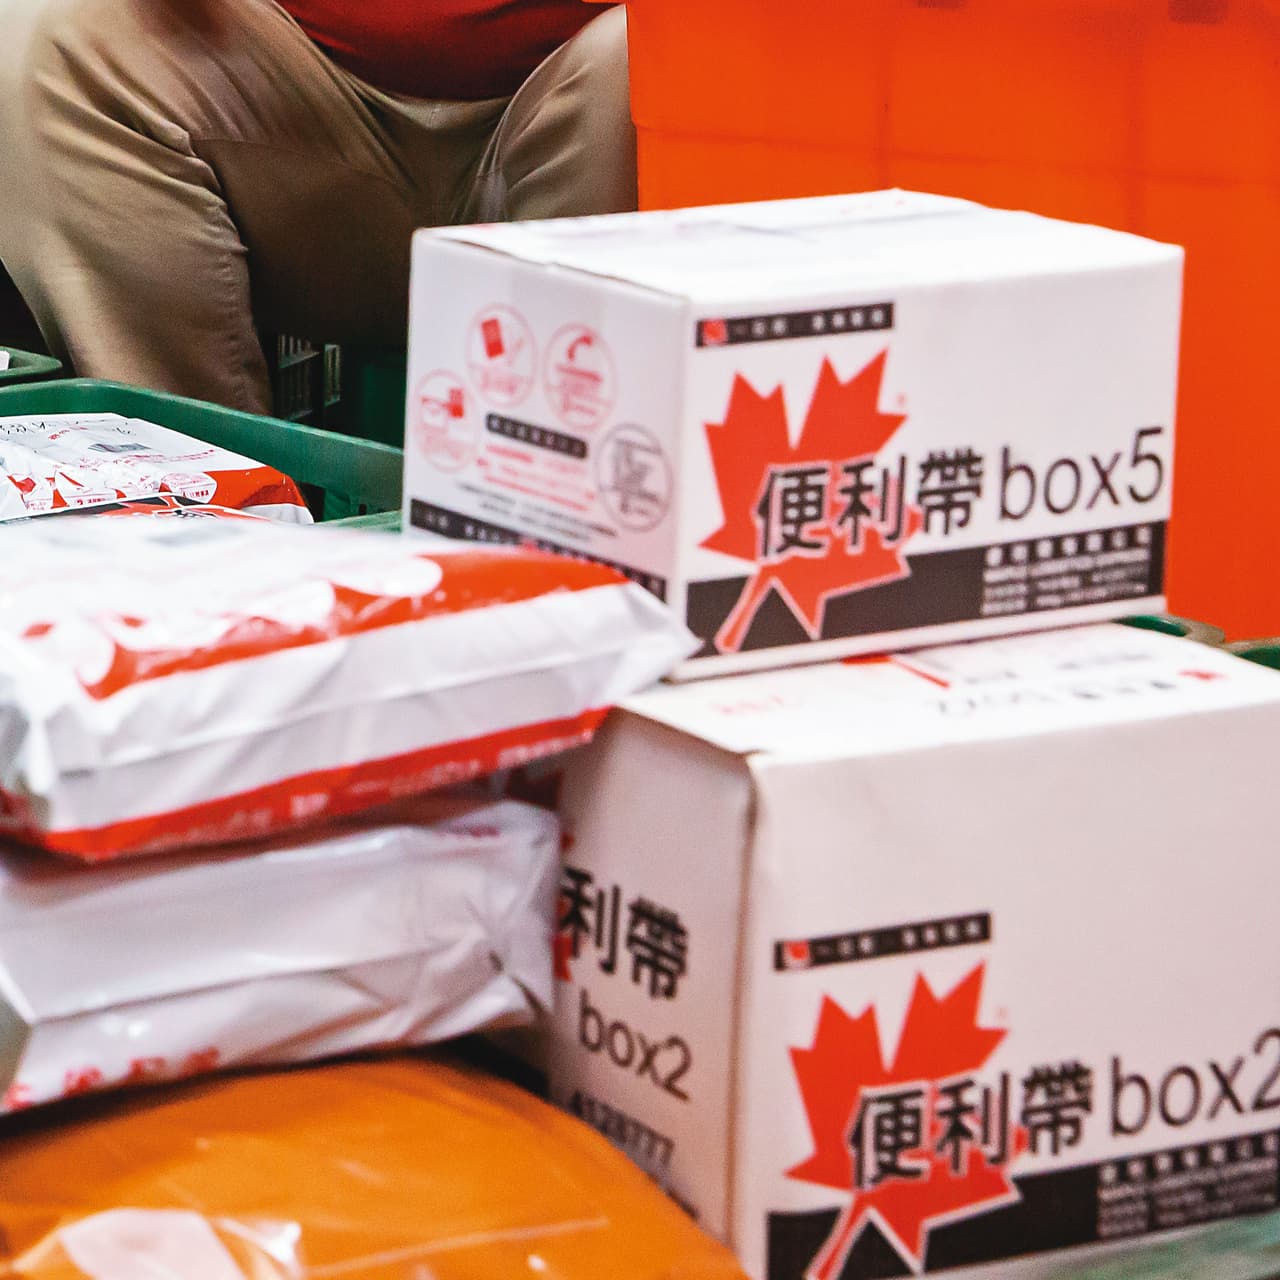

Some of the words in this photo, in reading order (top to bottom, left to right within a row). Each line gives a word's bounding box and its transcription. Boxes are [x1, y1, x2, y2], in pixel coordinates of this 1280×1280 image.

[756, 446, 985, 559] 便利帶
[998, 425, 1165, 522] box5
[560, 866, 688, 1000] 利帶
[578, 987, 691, 1104] box2
[846, 1058, 1094, 1189] 便利帶
[1110, 1026, 1280, 1136] box2
